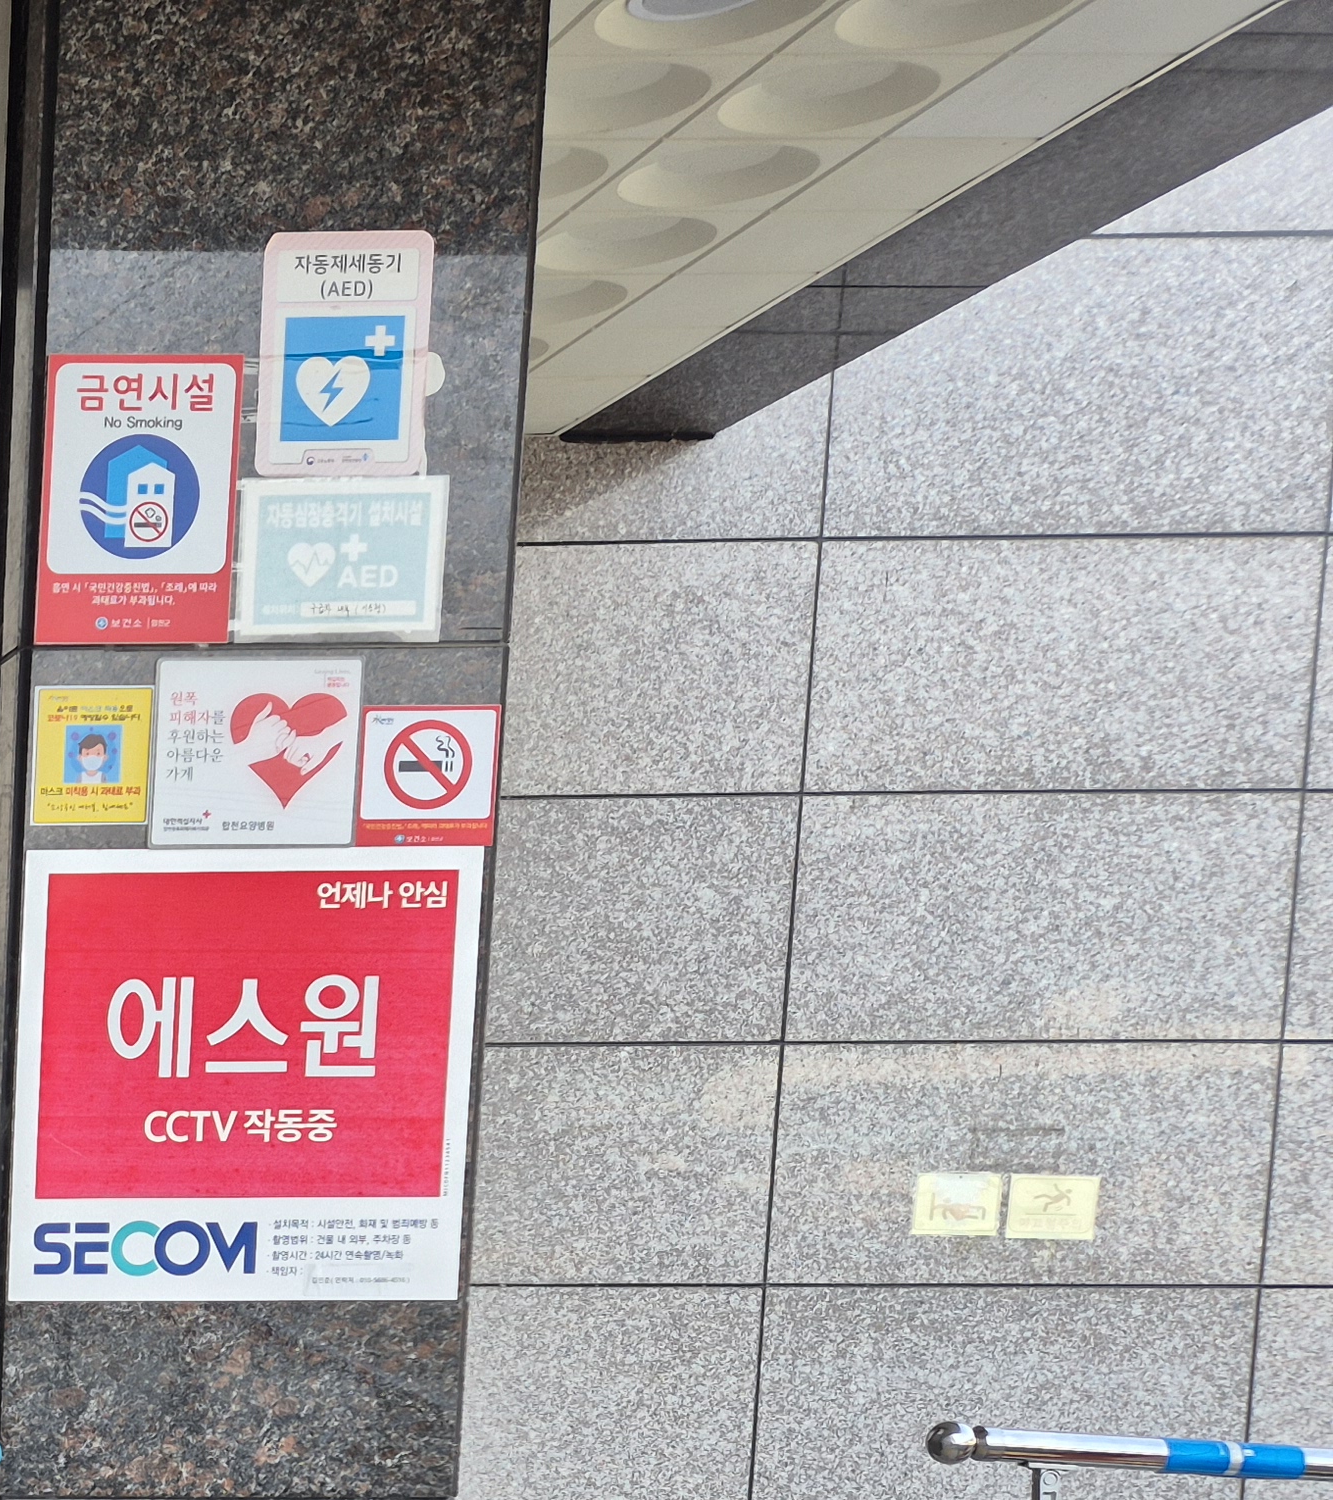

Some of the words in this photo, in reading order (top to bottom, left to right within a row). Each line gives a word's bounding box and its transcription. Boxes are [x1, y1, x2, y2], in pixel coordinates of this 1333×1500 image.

[295, 253, 402, 275] 자동제세동기
[320, 279, 373, 300] (AED)
[76, 373, 216, 413] 금연시설
[104, 416, 122, 429] No
[126, 416, 183, 431] Smoking
[267, 502, 362, 528] 자동심장충격기
[368, 500, 423, 526] 설치시설
[337, 565, 399, 588] AED
[111, 619, 142, 628] 보건소
[170, 710, 226, 725] 피해자를
[167, 729, 225, 744] 후원하는
[166, 747, 224, 763] 아름다운
[166, 767, 193, 782] 가게
[40, 787, 63, 796] 마스크
[222, 821, 275, 831] 합천요양병원
[317, 880, 393, 909] 언제나
[399, 880, 447, 908] 안심
[107, 974, 380, 1078] 에스원
[144, 1110, 237, 1143] CCTV
[243, 1109, 337, 1143] 작동중
[273, 1219, 309, 1229] 설치목적
[359, 1219, 377, 1229] 화재
[273, 1235, 308, 1245] 촬영범위
[316, 1235, 334, 1245] 건물
[337, 1235, 345, 1244] 내
[373, 1235, 400, 1244] 주차장
[33, 1220, 257, 1276] SECOM
[272, 1251, 307, 1261] 촬영시간
[315, 1251, 342, 1260] 24시간
[272, 1267, 297, 1276] 책임자
